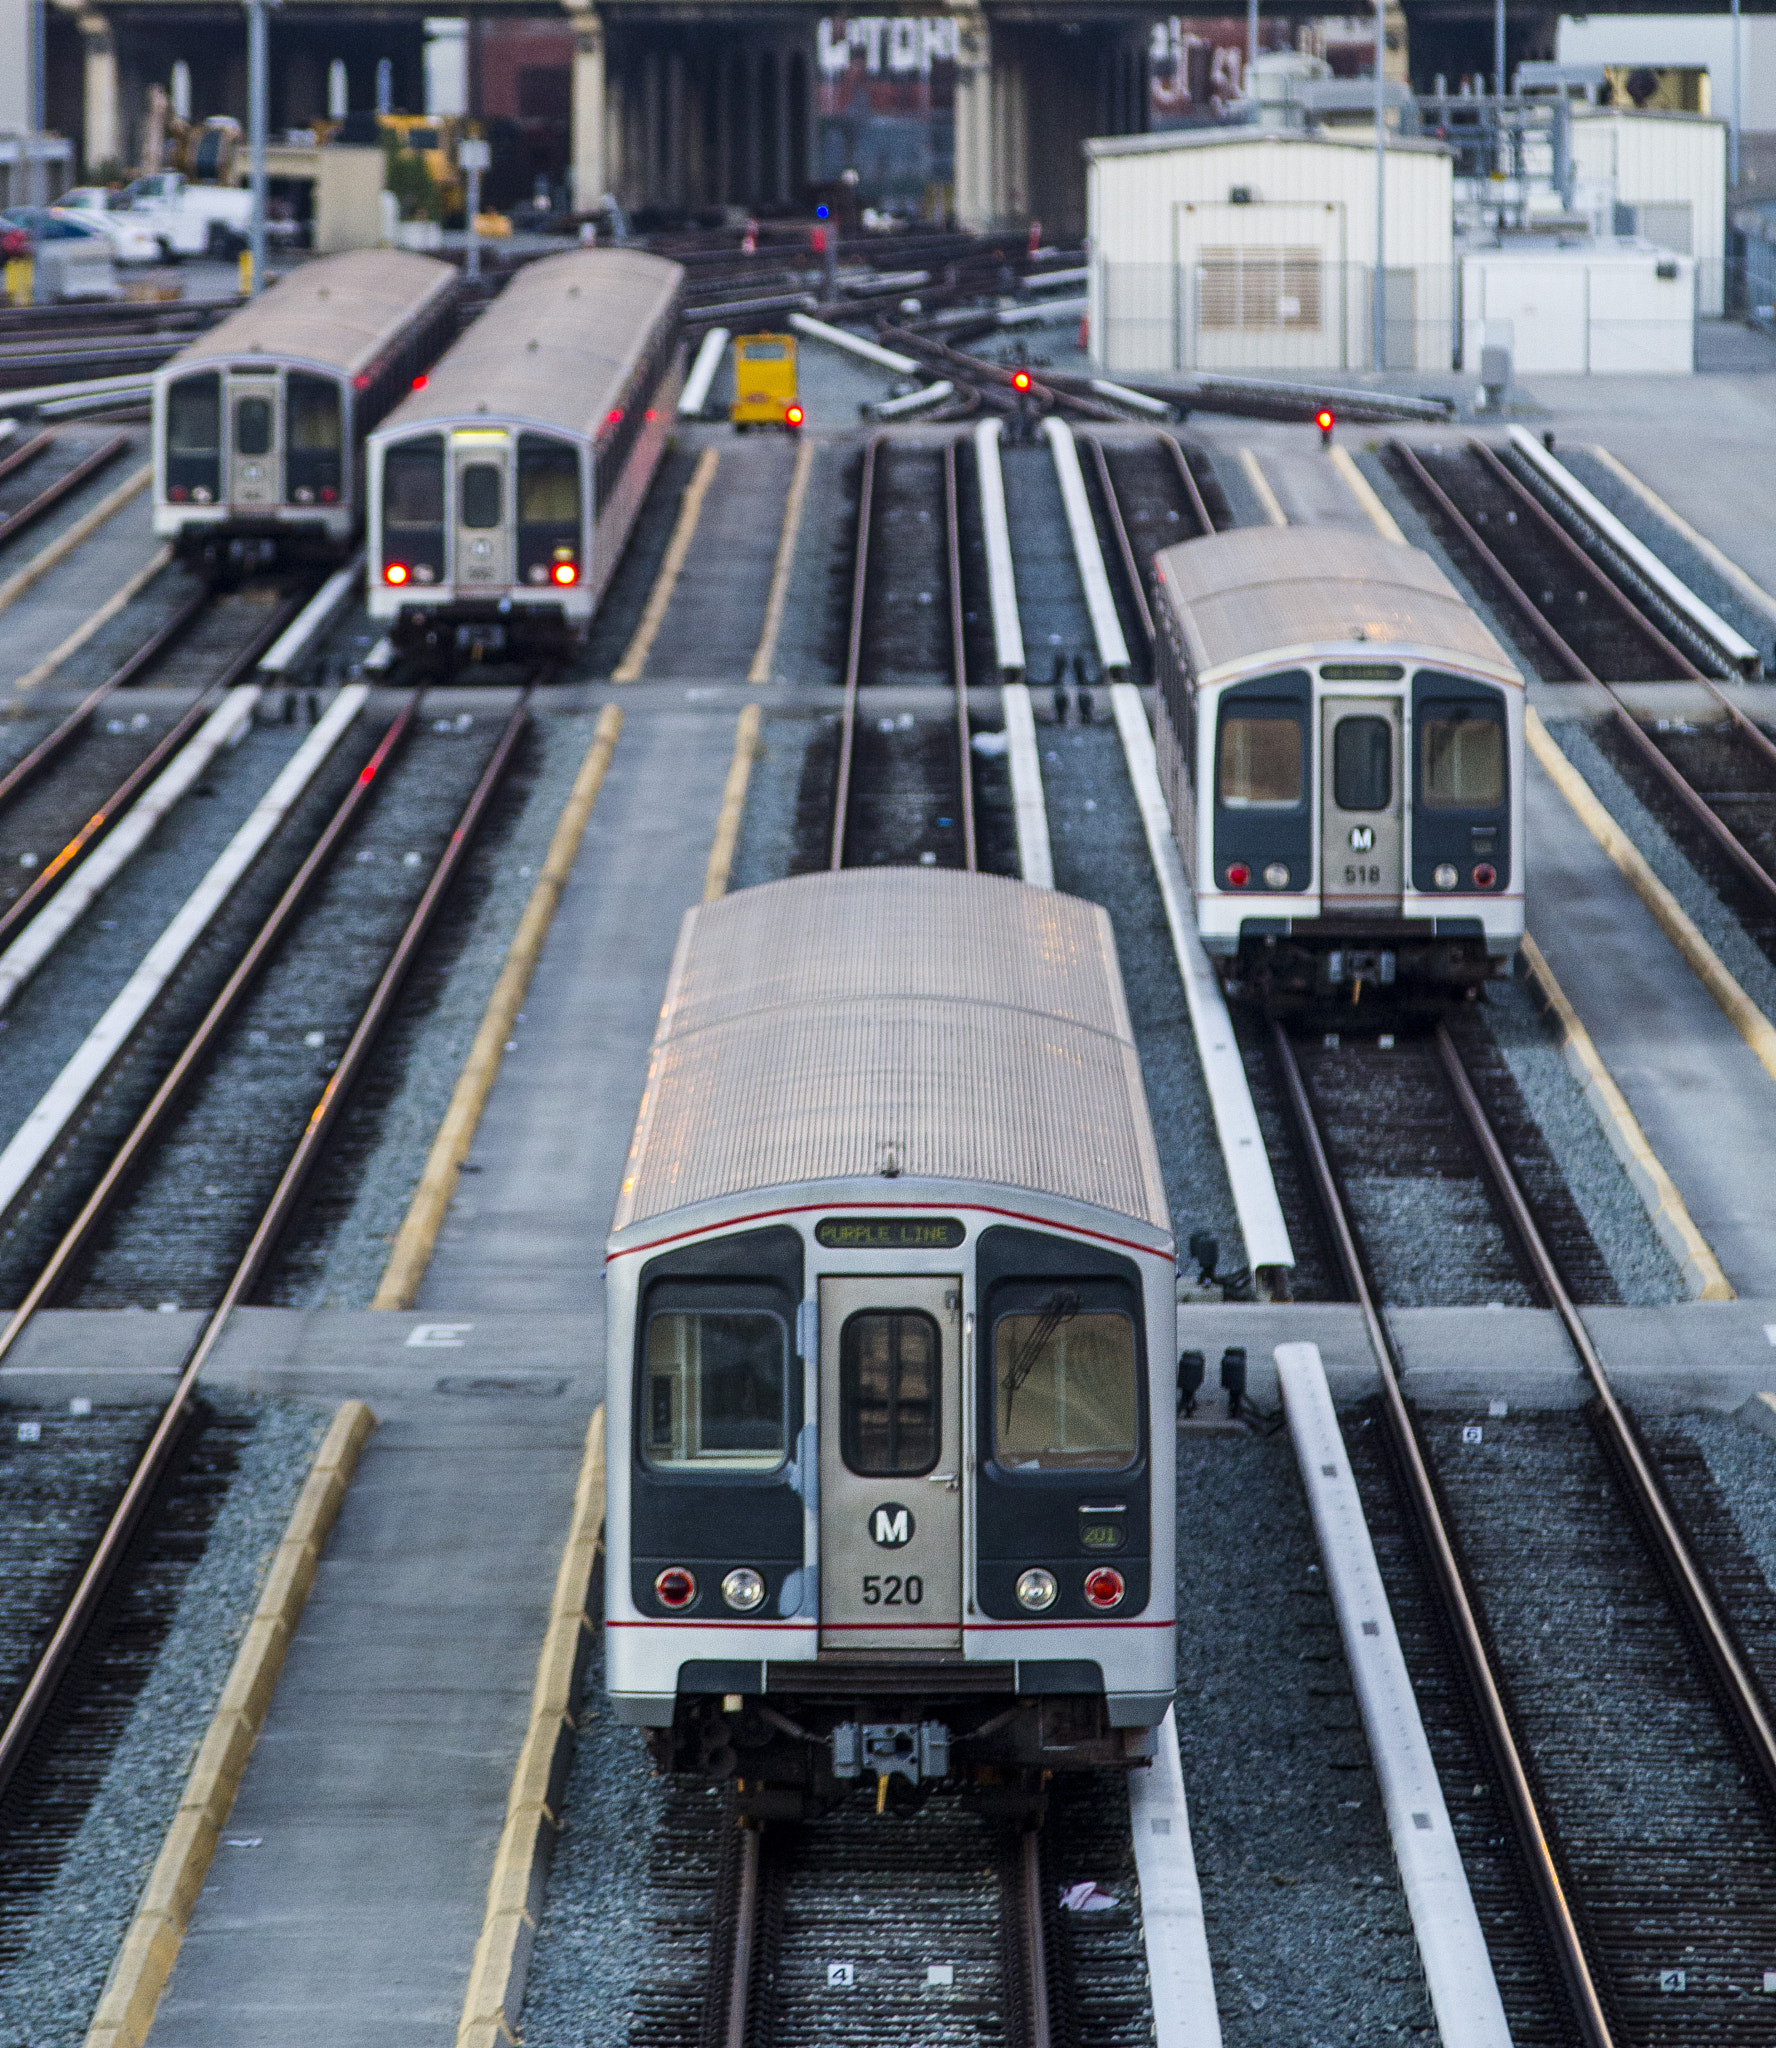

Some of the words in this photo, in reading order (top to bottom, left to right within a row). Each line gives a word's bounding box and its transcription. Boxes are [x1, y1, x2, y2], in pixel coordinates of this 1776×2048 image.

[1351, 828, 1372, 850] M
[1344, 865, 1380, 884] 518
[821, 1225, 890, 1242] PURPLE
[901, 1225, 948, 1242] LINE
[876, 1510, 908, 1542] M
[862, 1575, 924, 1605] 520
